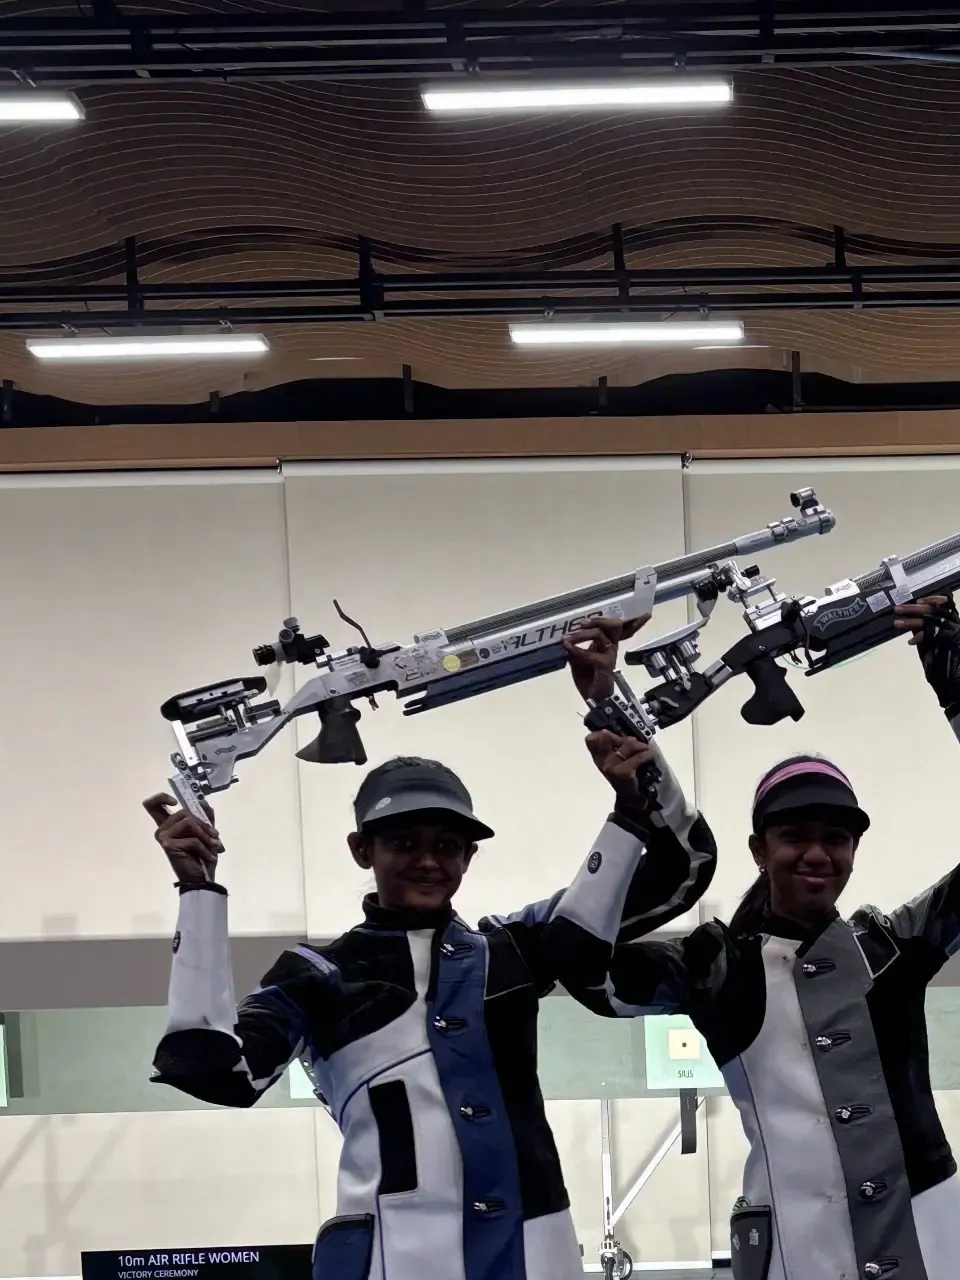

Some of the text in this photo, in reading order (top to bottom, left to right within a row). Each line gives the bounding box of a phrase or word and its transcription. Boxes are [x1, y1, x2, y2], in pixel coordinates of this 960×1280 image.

[820, 604, 861, 623] WALTHER
[677, 1070, 694, 1078] SIUS
[117, 1251, 260, 1267] 10m AIR RIFLE WOMEN
[117, 1268, 199, 1280] VICTORY CEREMONY
